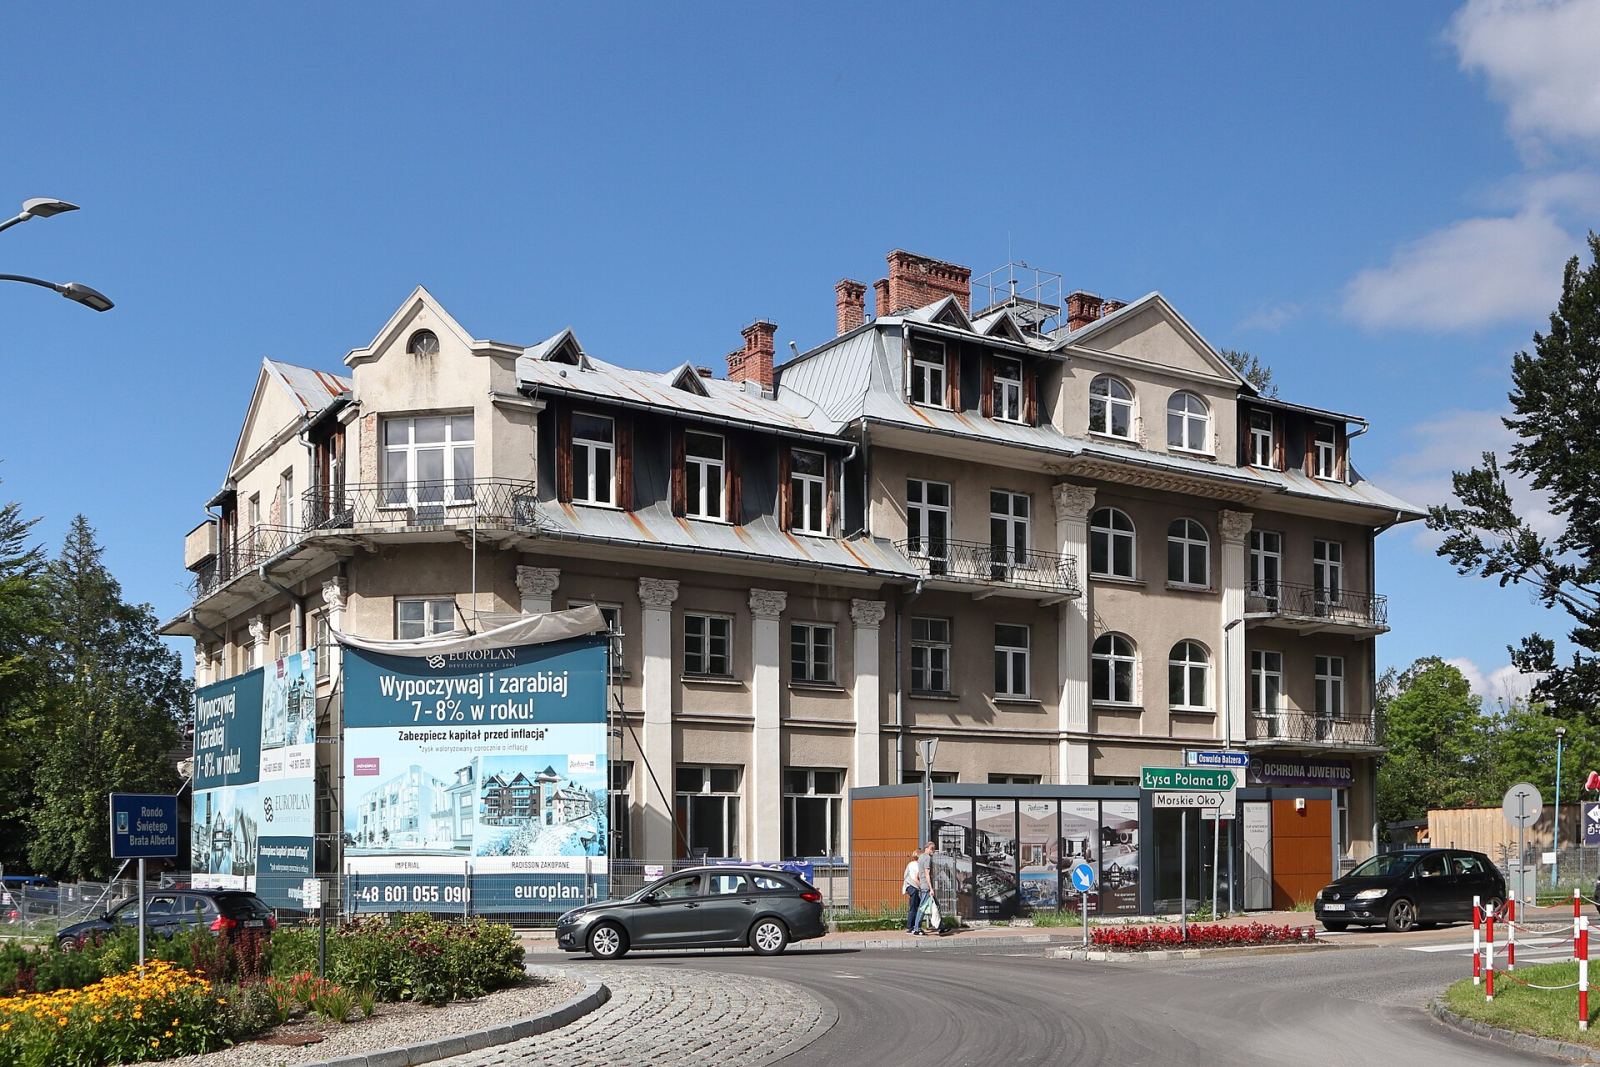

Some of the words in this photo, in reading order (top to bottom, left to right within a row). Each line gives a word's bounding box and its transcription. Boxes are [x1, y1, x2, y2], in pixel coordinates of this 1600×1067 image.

[449, 648, 516, 661] EUROPLAN
[380, 673, 483, 701] Wypoczywaj
[489, 672, 494, 693] i
[499, 671, 568, 698] zarabiaj
[197, 686, 236, 726] Wypoczywaj
[470, 706, 483, 720] w
[490, 698, 534, 721] roku!
[200, 719, 225, 751] zarabiaj
[398, 730, 447, 745] Zabezpiecz
[449, 729, 481, 743] kapitał
[484, 729, 509, 743] przed
[216, 757, 224, 775] w
[224, 748, 241, 775] roku!
[1198, 753, 1221, 764] Oswalda
[1222, 754, 1242, 765] Balzera
[1264, 763, 1305, 777] OCHRONA
[1307, 765, 1351, 779] JUWENTUS
[1145, 772, 1171, 788] Łysa
[1175, 773, 1213, 786] Polana
[1217, 774, 1229, 787] 18
[274, 793, 311, 812] EUROPLAN
[1157, 794, 1194, 806] Morskie
[1197, 794, 1216, 805] Oko
[141, 807, 163, 817] Rondo
[136, 818, 168, 833] Świętego
[130, 835, 149, 846] Brata
[150, 835, 175, 846] Alberta
[395, 861, 420, 869] IMPERIAL
[511, 861, 538, 869] RADISSON
[540, 861, 570, 869] ZAKOPANE
[353, 886, 379, 902] +48
[384, 885, 408, 902] 601
[412, 885, 439, 902] 055
[444, 886, 471, 903] 090
[514, 881, 598, 903] europlan.pl
